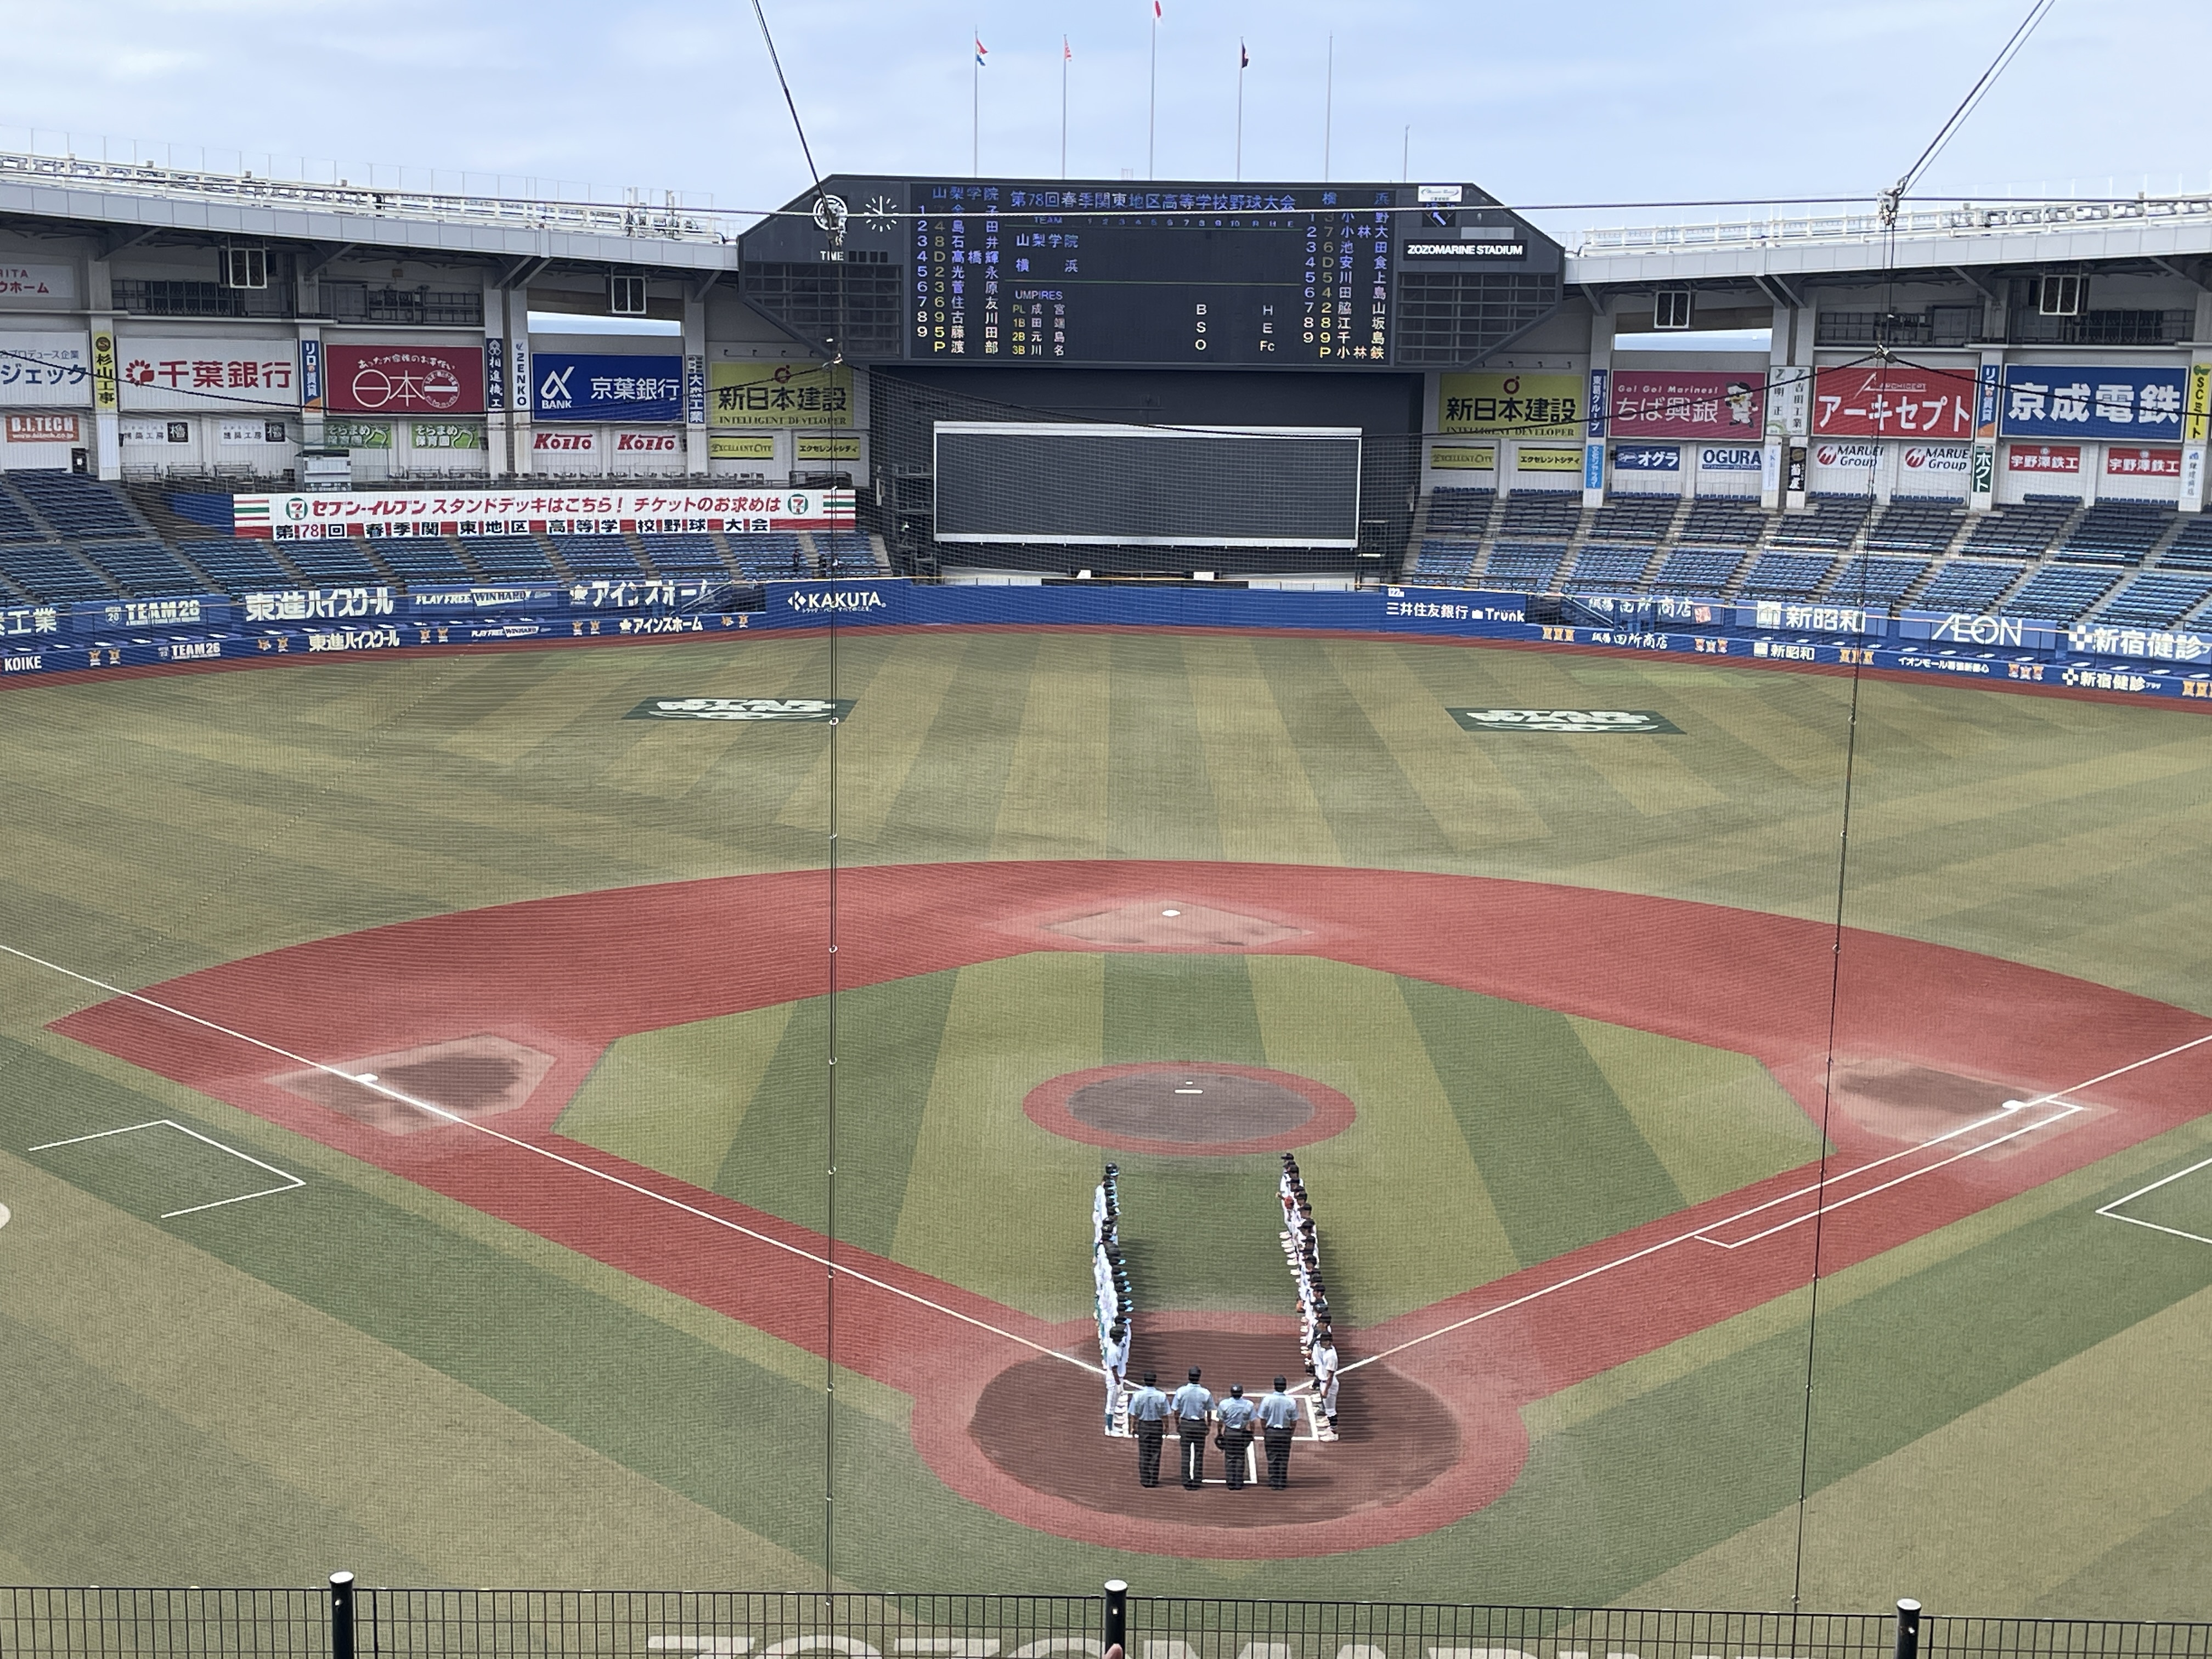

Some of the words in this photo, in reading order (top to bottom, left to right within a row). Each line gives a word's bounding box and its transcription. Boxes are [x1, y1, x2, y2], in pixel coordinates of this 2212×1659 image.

[917, 221, 927, 232] 2
[934, 221, 946, 232] 4
[1307, 226, 1317, 237] 2
[1324, 226, 1334, 237] 7
[917, 235, 927, 246] 3
[935, 236, 944, 247] 8
[1016, 233, 1079, 248] 山梨学院
[1306, 241, 1316, 252] 3
[1323, 241, 1334, 253] 6
[1407, 245, 1476, 255] ZOZOMARINE
[1476, 245, 1523, 255] STADIUM
[820, 250, 844, 262] TIME
[917, 251, 928, 262] 4
[934, 251, 945, 262] D
[1016, 258, 1079, 273] 横浜
[1305, 257, 1316, 268] 4
[1322, 257, 1334, 268] D
[917, 266, 927, 277] 5
[935, 266, 945, 277] 2
[1305, 272, 1315, 283] 5
[1323, 272, 1332, 283] 5
[917, 281, 927, 292] 6
[935, 281, 945, 292] 3
[1015, 291, 1063, 301] UMPIRES
[1305, 287, 1315, 298] 6
[1322, 287, 1333, 298] 4
[917, 296, 927, 307] 7
[935, 296, 945, 307] 6
[1012, 304, 1025, 314] PL
[1196, 304, 1206, 315] B
[1263, 305, 1273, 316] H
[1305, 302, 1314, 313] 7
[1321, 302, 1332, 313] 2
[917, 311, 927, 322] 8
[935, 311, 945, 322] 9
[1013, 318, 1025, 328] 1B
[1196, 321, 1206, 334] S
[1263, 322, 1273, 334] E
[1304, 317, 1314, 328] 8
[1321, 317, 1331, 328] 8
[917, 326, 927, 337] 9
[934, 326, 945, 337] 5
[1012, 332, 1025, 342] 2B
[1304, 332, 1313, 343] 9
[1321, 332, 1331, 343] 9
[934, 341, 946, 352] P
[1012, 345, 1025, 355] 3B
[1031, 345, 1065, 356] 川名
[1319, 347, 1331, 358] P
[157, 360, 292, 389] 千葉銀行
[516, 353, 527, 406] ZENKO
[590, 376, 680, 401] 京葉銀行
[1618, 385, 1637, 393] Go!
[1643, 385, 1662, 393] Go!
[1667, 385, 1718, 394] Marines!
[718, 386, 847, 411] 新日本建設
[2008, 382, 2181, 425] 京成電鉄
[541, 400, 572, 409] BANK
[1616, 396, 1718, 424] ちば興銀
[1446, 397, 1577, 424] 新日本建設
[1818, 393, 1970, 432] アーキセプト
[328, 425, 370, 435] そらまめ
[416, 425, 458, 436] そらまめ
[1638, 450, 1678, 467] オグラ
[1703, 449, 1762, 465] OGURA
[1926, 448, 1971, 459] MARUE
[1520, 455, 1580, 464] エクセレントシティ
[1840, 456, 1877, 468] Group
[1928, 459, 1967, 471] Group
[1976, 453, 1991, 493] ホクト
[635, 496, 782, 514] チケットのお求めは
[245, 586, 394, 622] 東進ハイスクール
[809, 591, 881, 608] KAKUTA
[1386, 602, 1468, 620] 三井住友銀行
[1485, 607, 1525, 622] Trunk
[634, 616, 703, 633] アインスホーム
[1786, 605, 1866, 634] 新昭和
[309, 630, 400, 653] 東進ハイスクール
[1770, 646, 1815, 661] 新昭和
[4, 656, 42, 672] KOIKE
